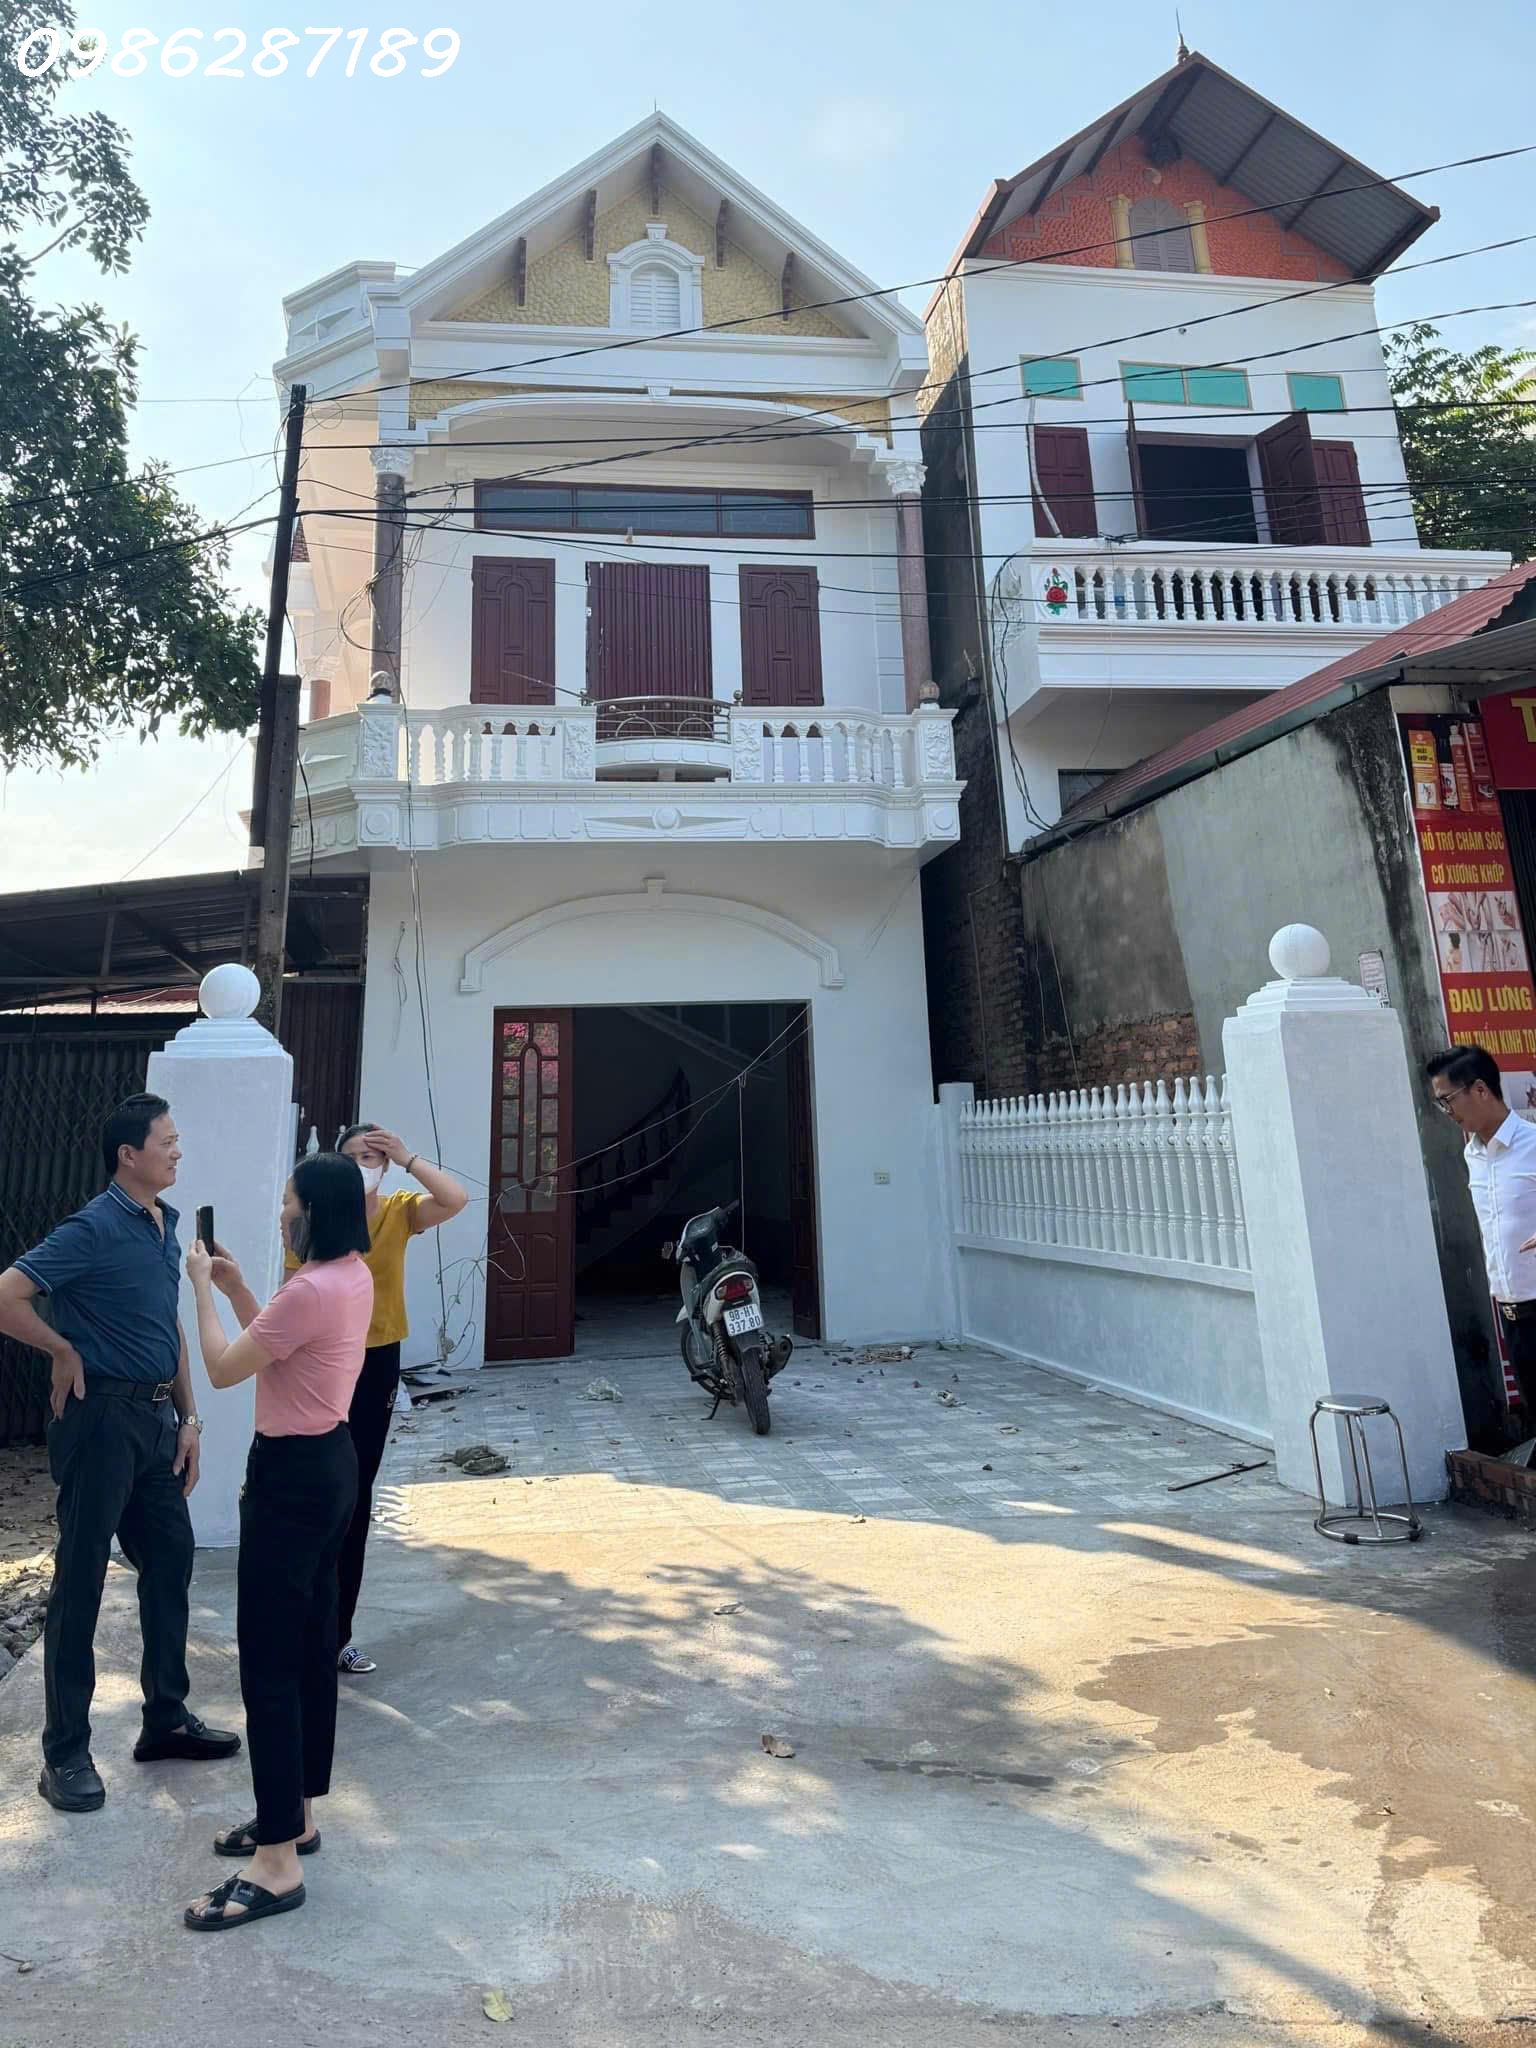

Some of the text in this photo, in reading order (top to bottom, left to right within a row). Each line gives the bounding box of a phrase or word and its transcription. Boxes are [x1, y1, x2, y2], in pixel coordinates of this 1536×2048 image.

[1435, 830, 1455, 855] TRỢ
[1485, 827, 1504, 850] SÓC
[1431, 860, 1504, 884] CƠ XƯƠNG KHỚP
[1448, 984, 1533, 1013] ĐAU LƯNG
[1499, 1029, 1523, 1054] KINH
[1522, 1028, 1536, 1059] TỌ
[729, 1305, 755, 1321] 98-H1
[729, 1315, 761, 1334] 337.80
